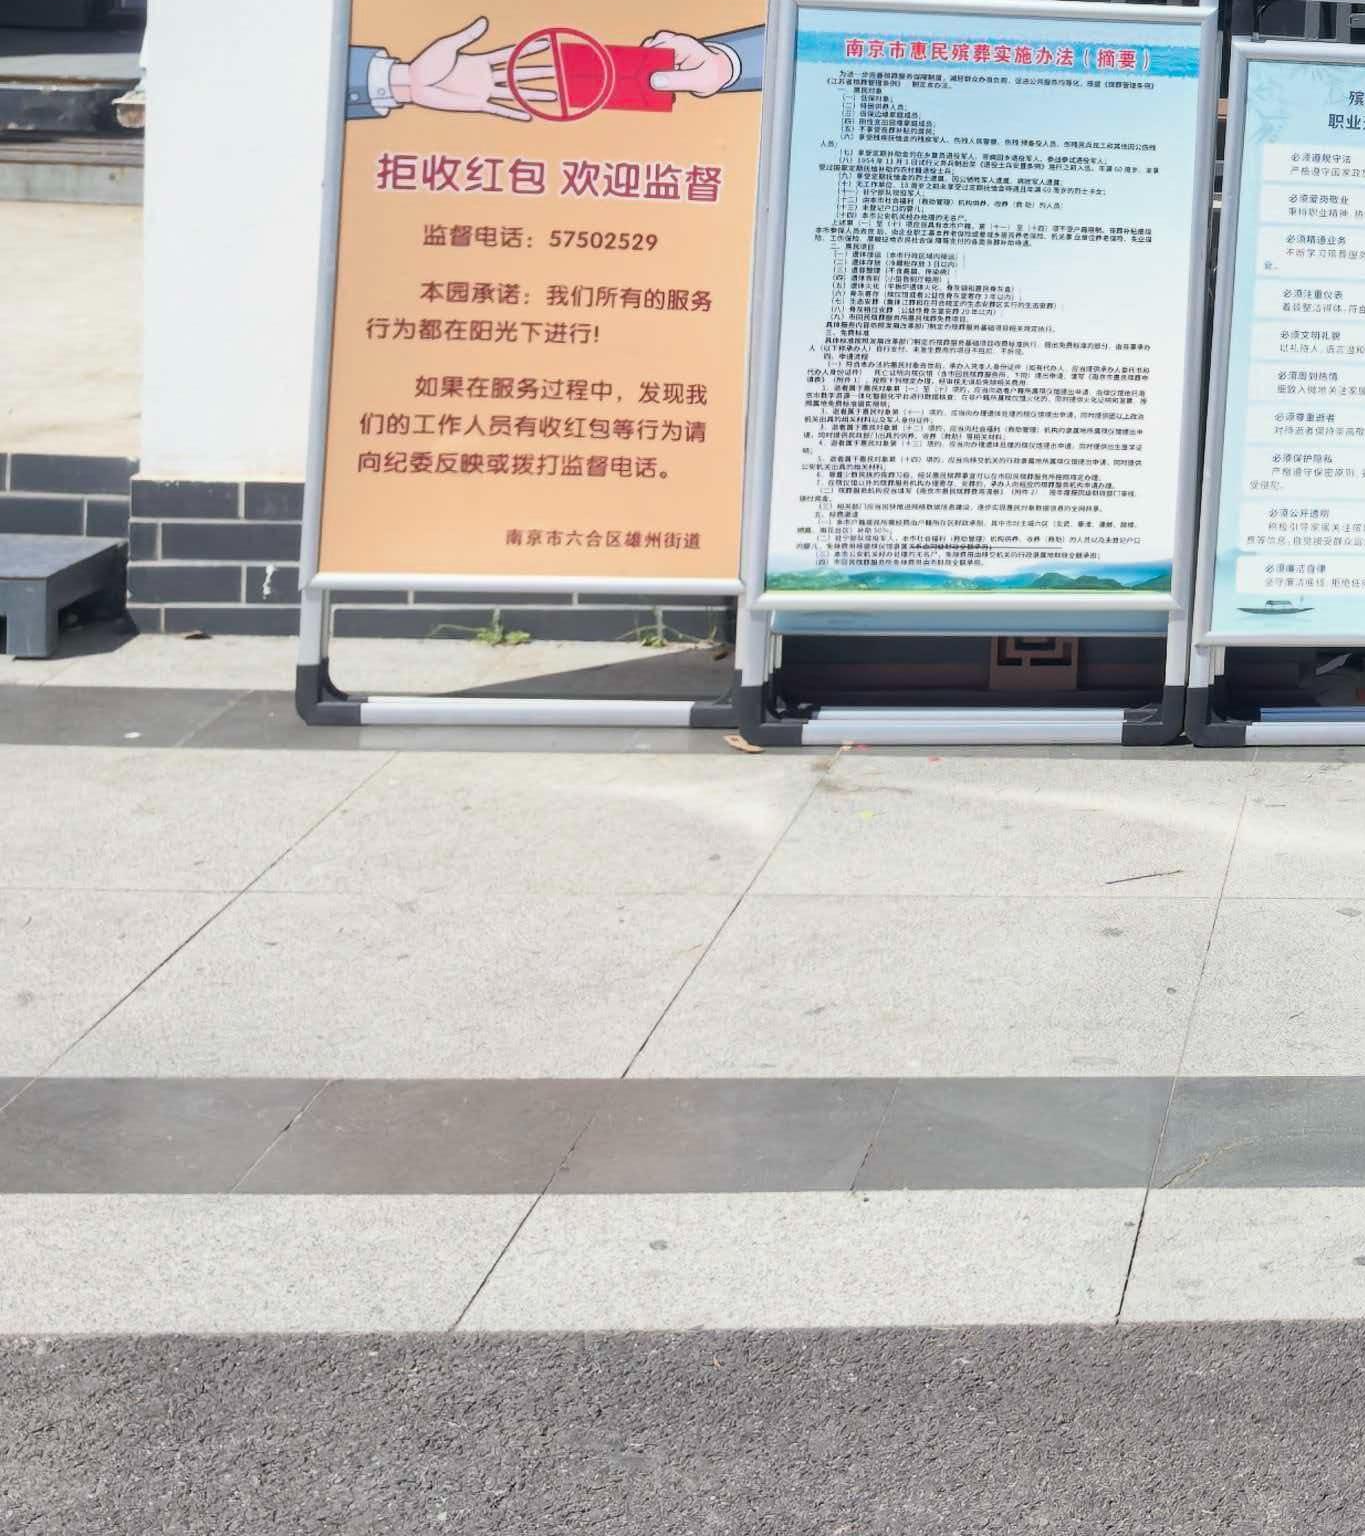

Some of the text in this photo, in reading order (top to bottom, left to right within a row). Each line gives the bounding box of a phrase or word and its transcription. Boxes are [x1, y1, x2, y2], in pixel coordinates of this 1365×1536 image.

[844, 38, 1151, 71] 南京市惠民殡葬实施办法（摘要）
[376, 152, 723, 203] 拒收红包 欢迎监督
[423, 222, 657, 253] 监督电话：57502529
[420, 280, 713, 312] 本园承诺：我们所有的服务
[414, 375, 707, 406] 如果在服务过程中，发现我
[359, 412, 706, 443] 们的工作人员有收红包等行为请
[358, 451, 670, 480] 向纪委反映或拨打监督电话。
[505, 528, 701, 550] 南京市六合区雄州街道
